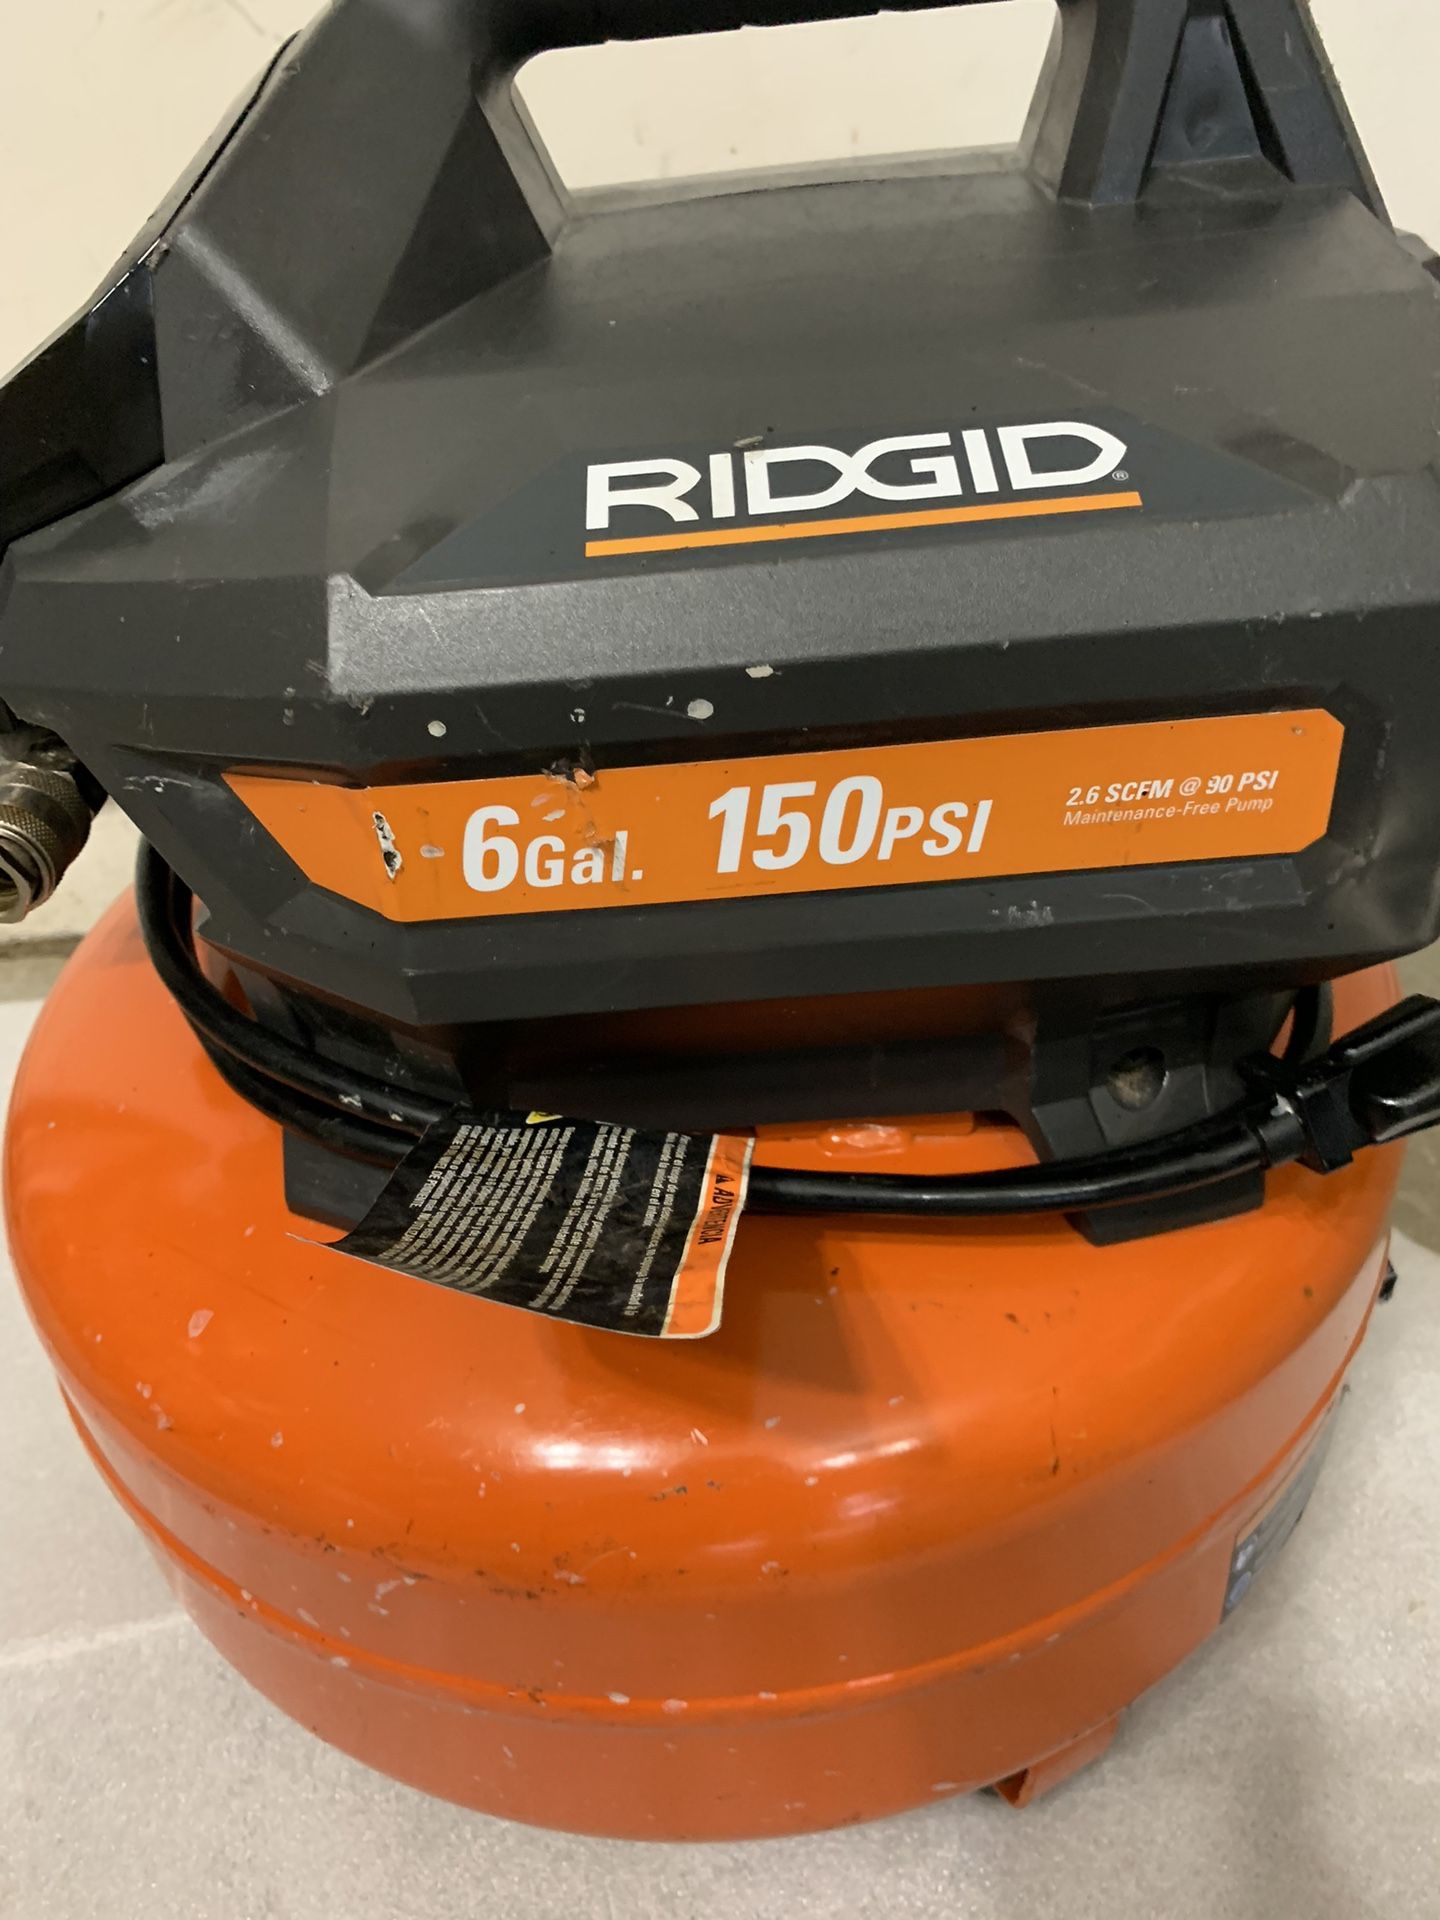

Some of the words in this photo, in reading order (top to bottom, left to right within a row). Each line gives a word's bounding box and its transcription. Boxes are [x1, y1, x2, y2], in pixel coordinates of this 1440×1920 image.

[585, 421, 1127, 530] RIDGID
[1066, 786, 1101, 806] 2.6
[1105, 779, 1174, 802] SCFM
[1179, 777, 1201, 796] @
[1206, 775, 1233, 794] 90
[1237, 770, 1278, 791] PSI
[1064, 800, 1220, 826] Maintenance-Free
[1225, 797, 1273, 813] Pump
